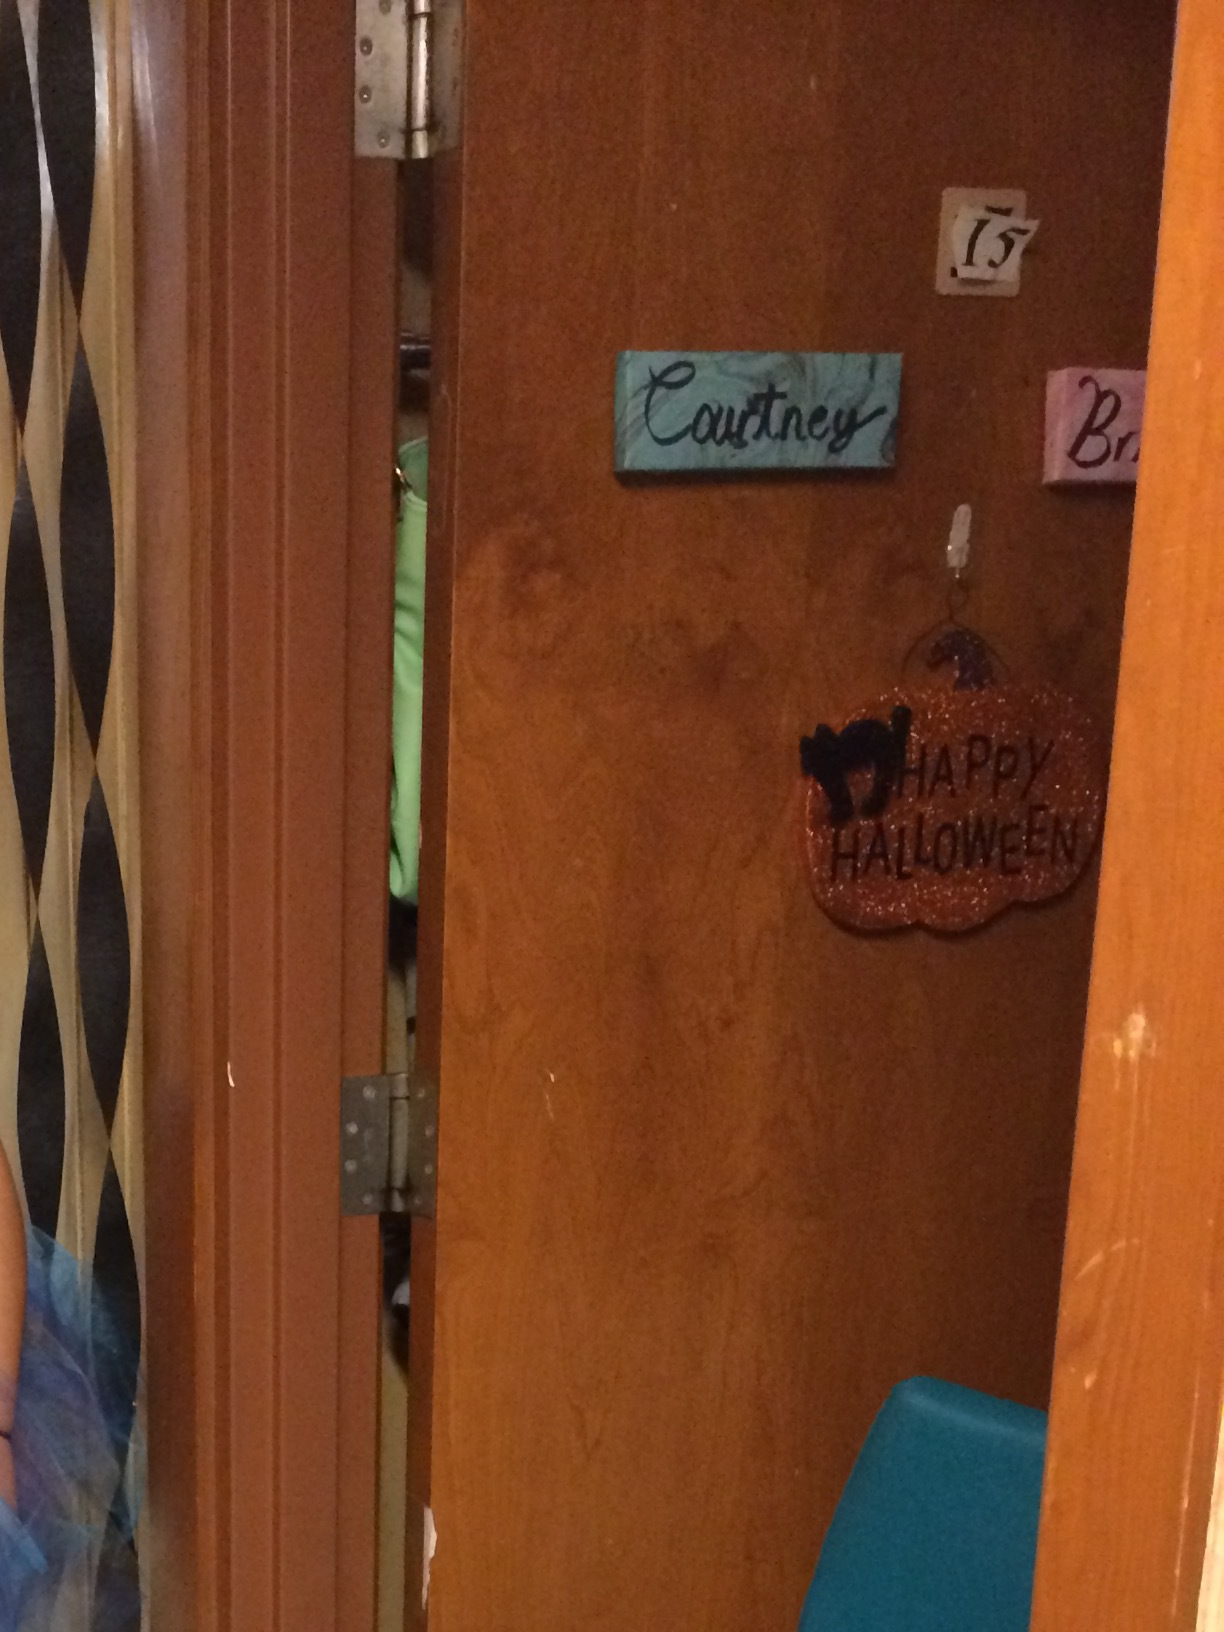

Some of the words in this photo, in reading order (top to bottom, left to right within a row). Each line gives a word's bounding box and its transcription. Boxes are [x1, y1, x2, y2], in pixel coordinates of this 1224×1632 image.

[644, 360, 888, 455] Courtney
[896, 734, 1056, 800] HAPPY
[830, 803, 1078, 882] HALLOWEEN
